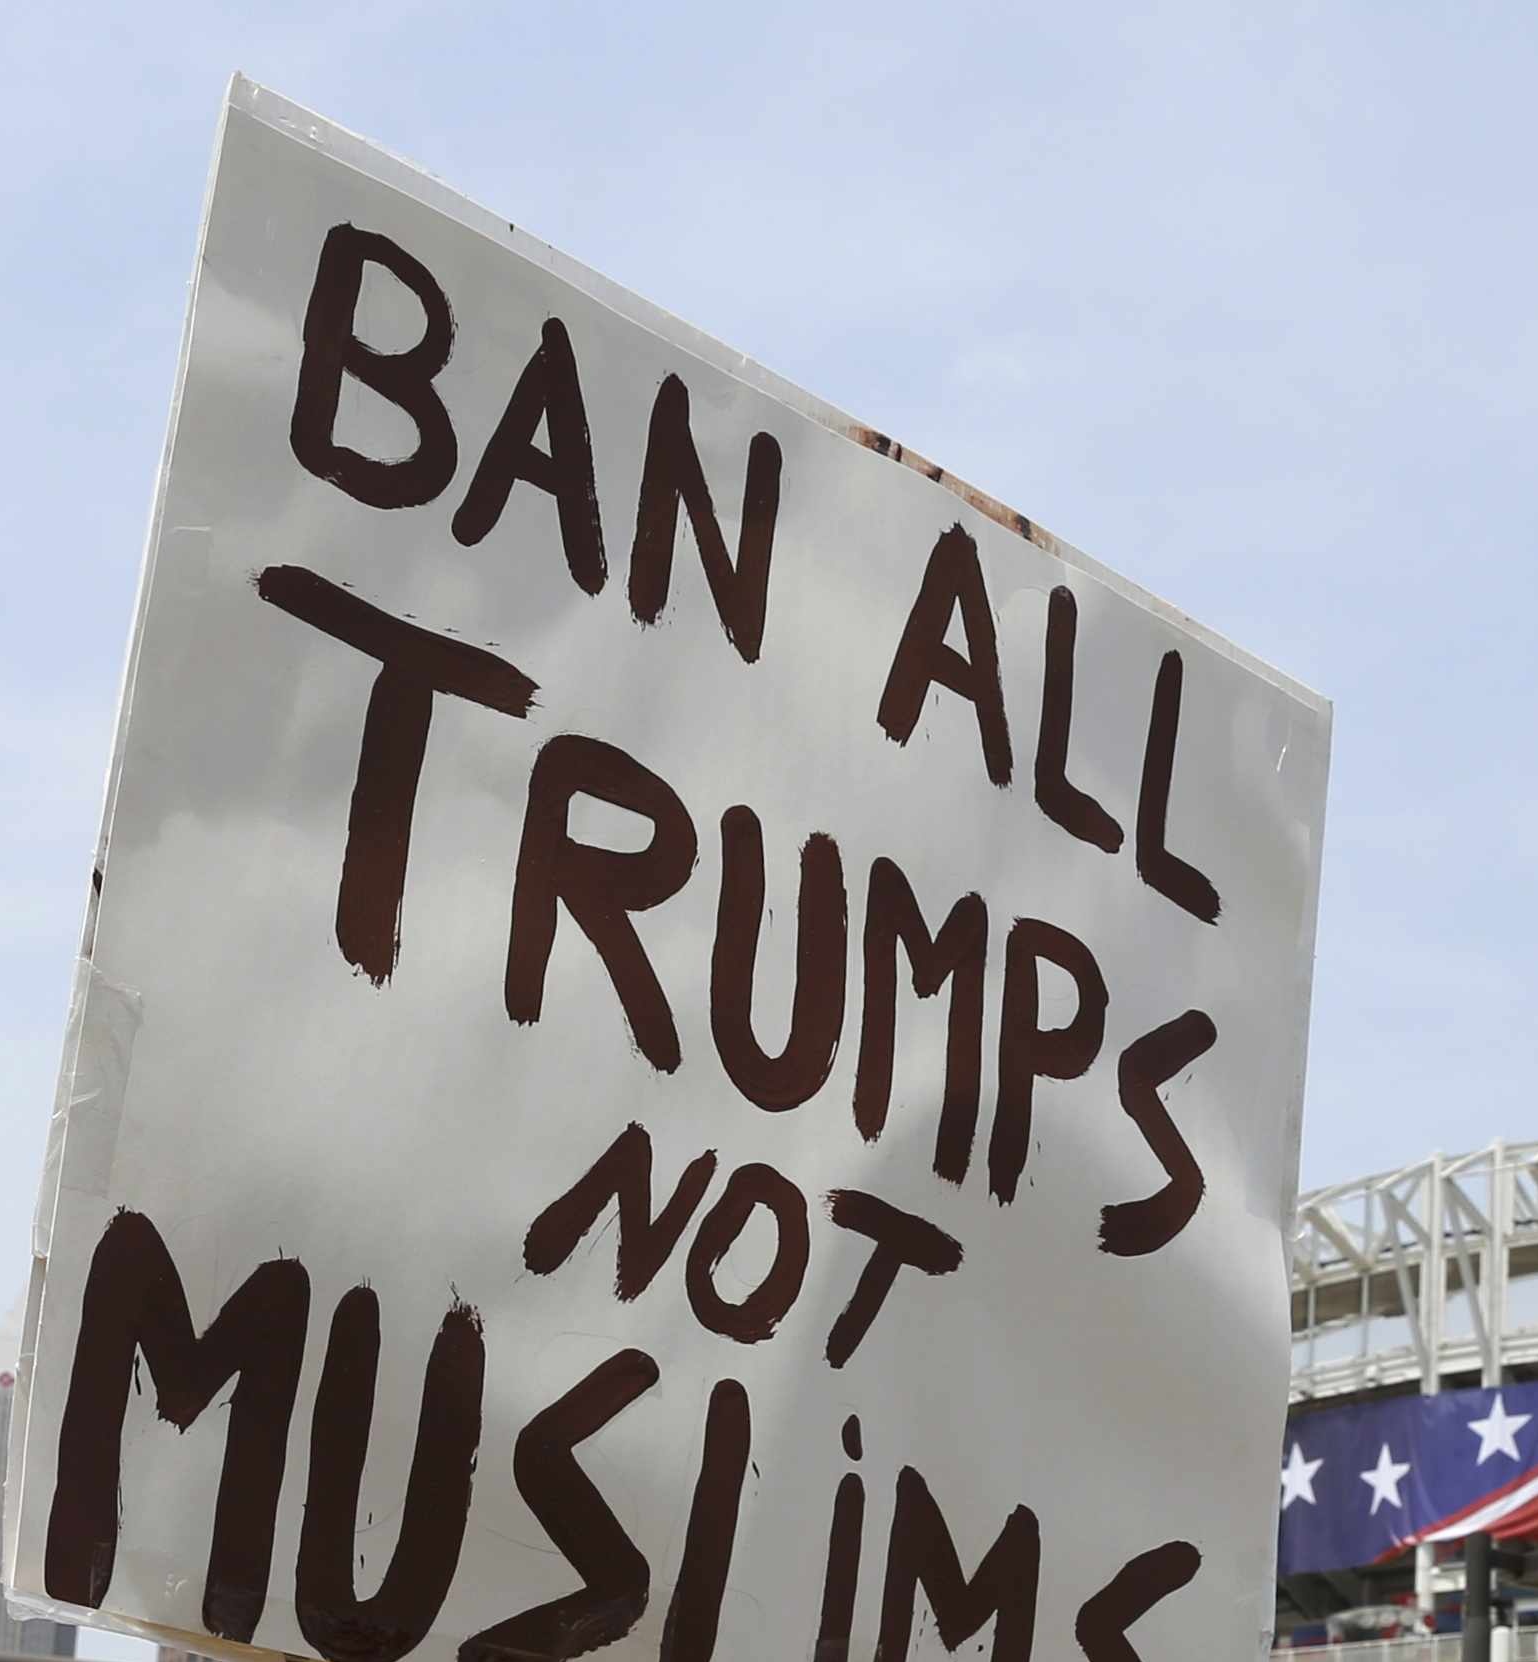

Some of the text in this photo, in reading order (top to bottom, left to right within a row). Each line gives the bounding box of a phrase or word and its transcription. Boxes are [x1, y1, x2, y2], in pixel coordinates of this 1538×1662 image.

[253, 564, 1217, 1256] TRUMPS
[289, 221, 1224, 925] BAN ALL
[522, 1122, 964, 1369] NOT
